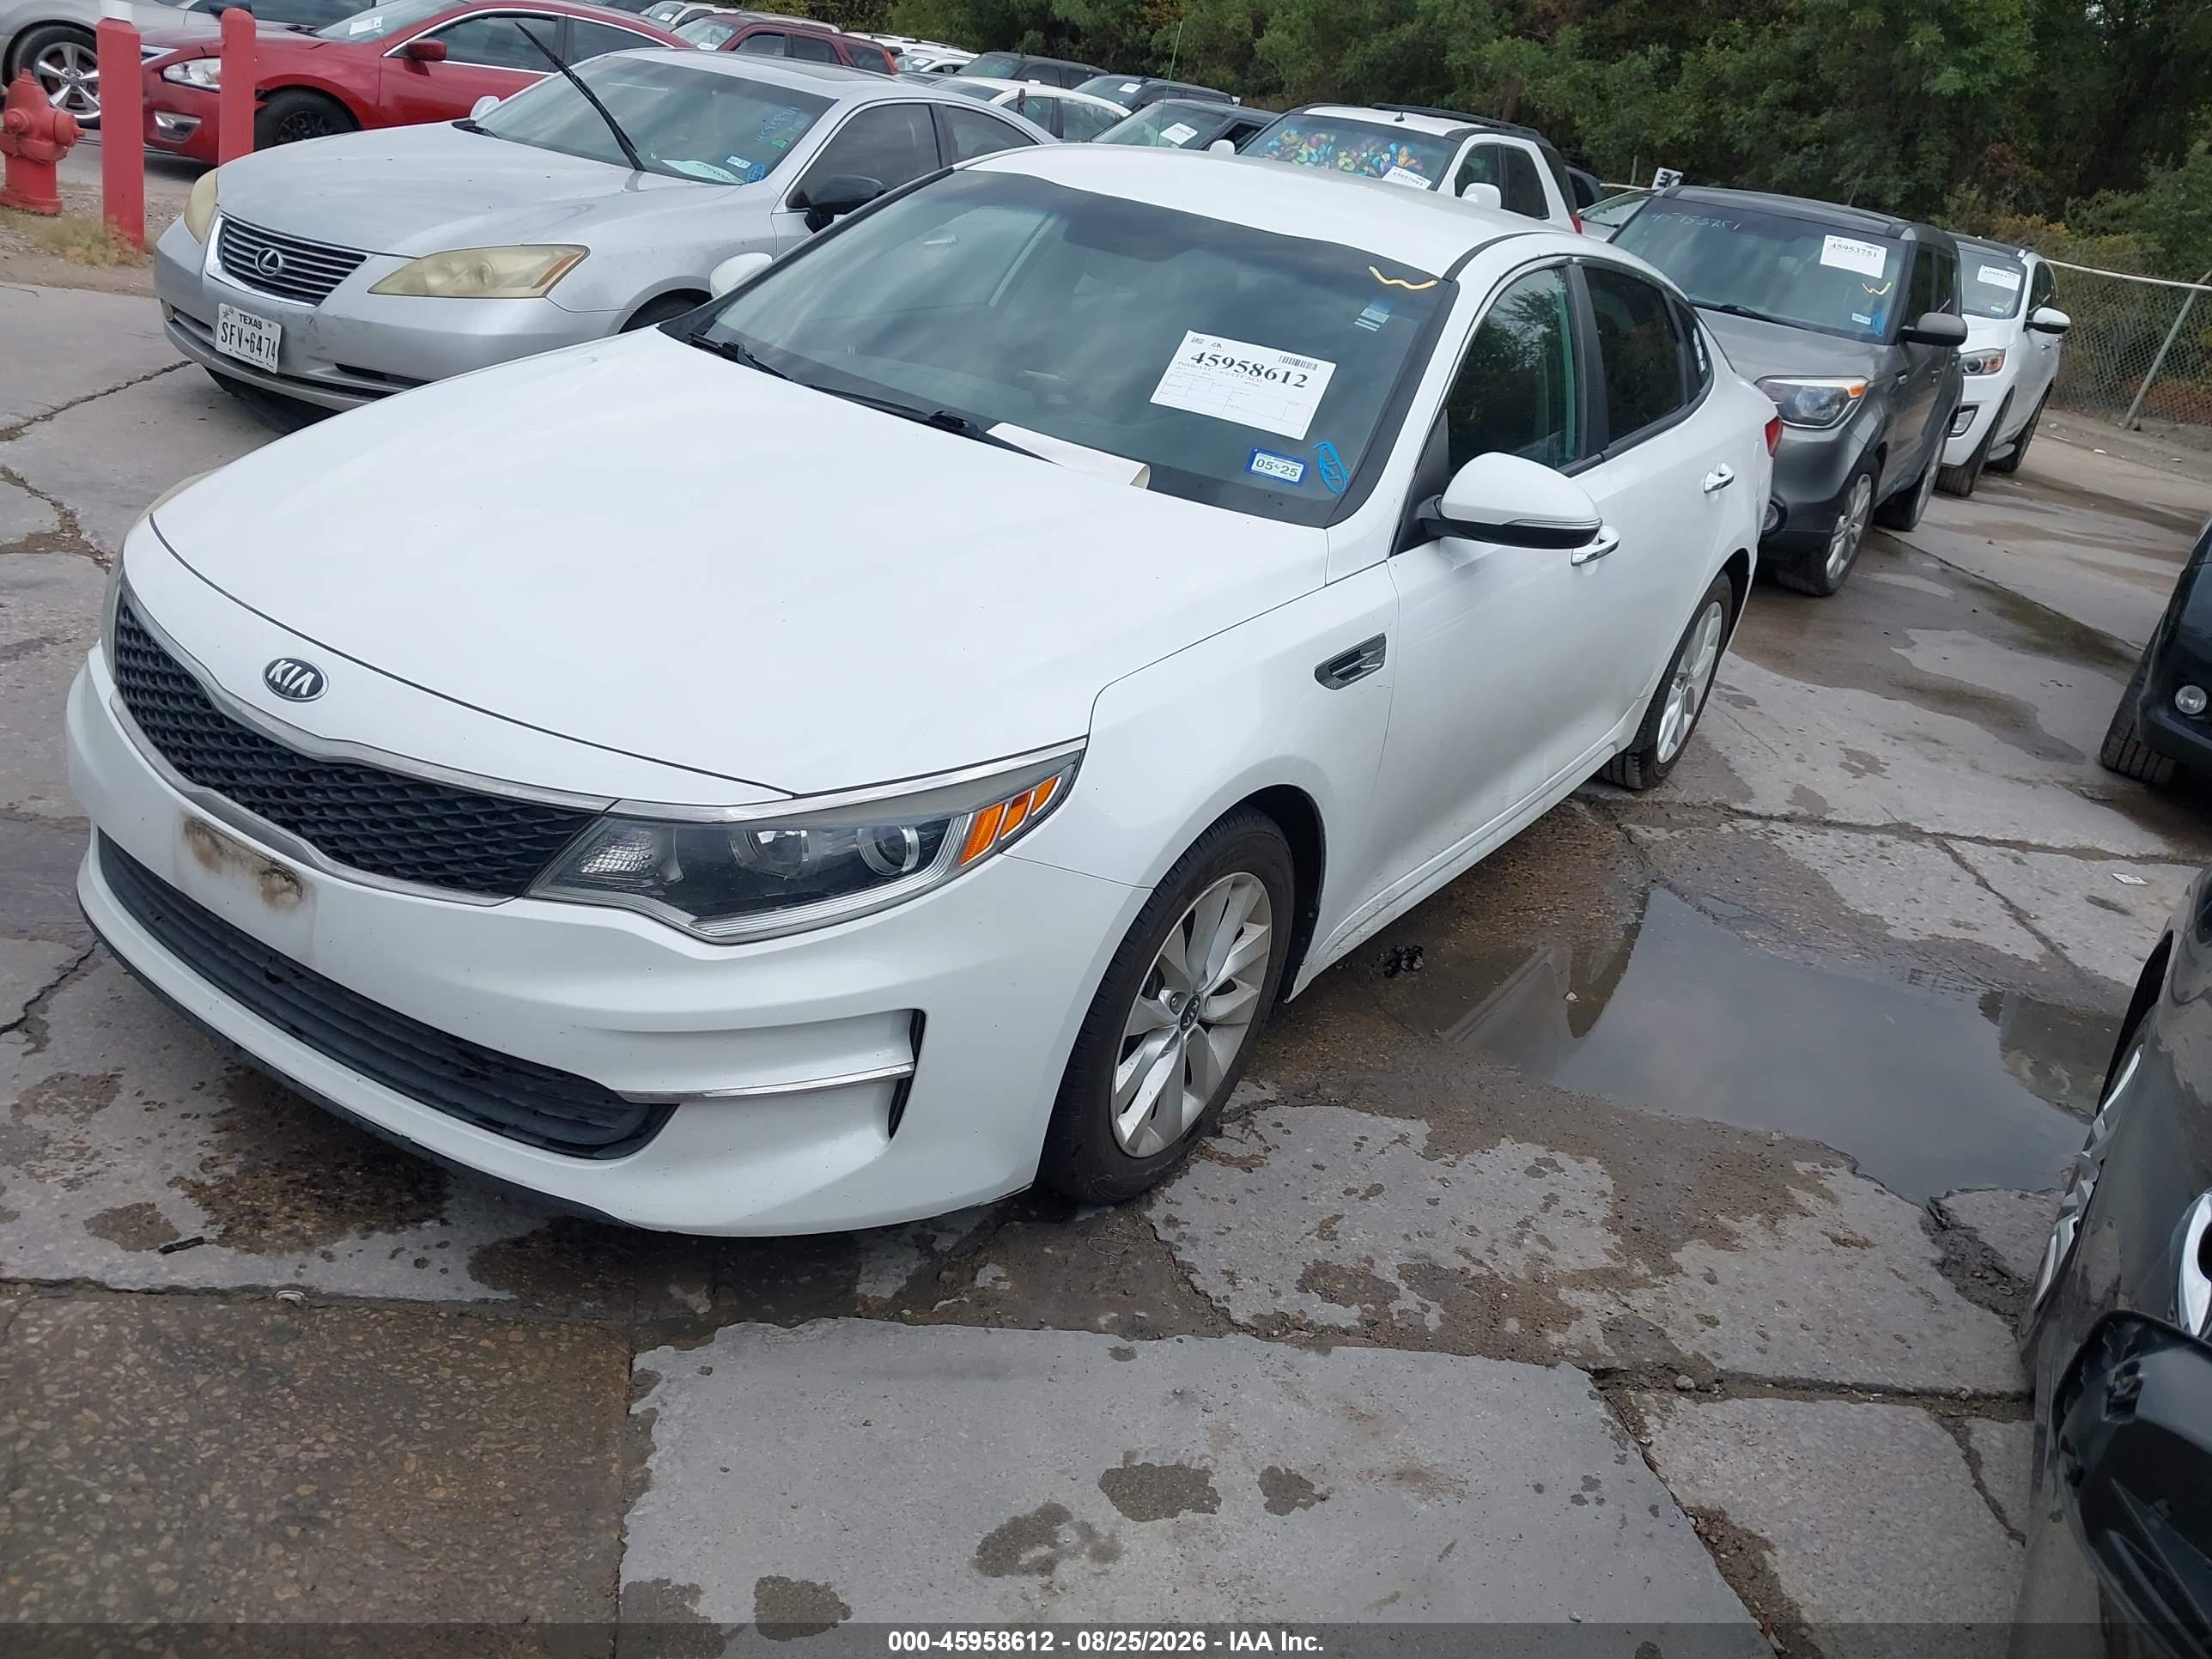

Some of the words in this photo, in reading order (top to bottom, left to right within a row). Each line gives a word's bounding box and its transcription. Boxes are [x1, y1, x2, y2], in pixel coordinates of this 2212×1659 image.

[238, 313, 263, 331] TEXAS
[1190, 351, 1309, 388] 45958612
[267, 659, 316, 696] KIA
